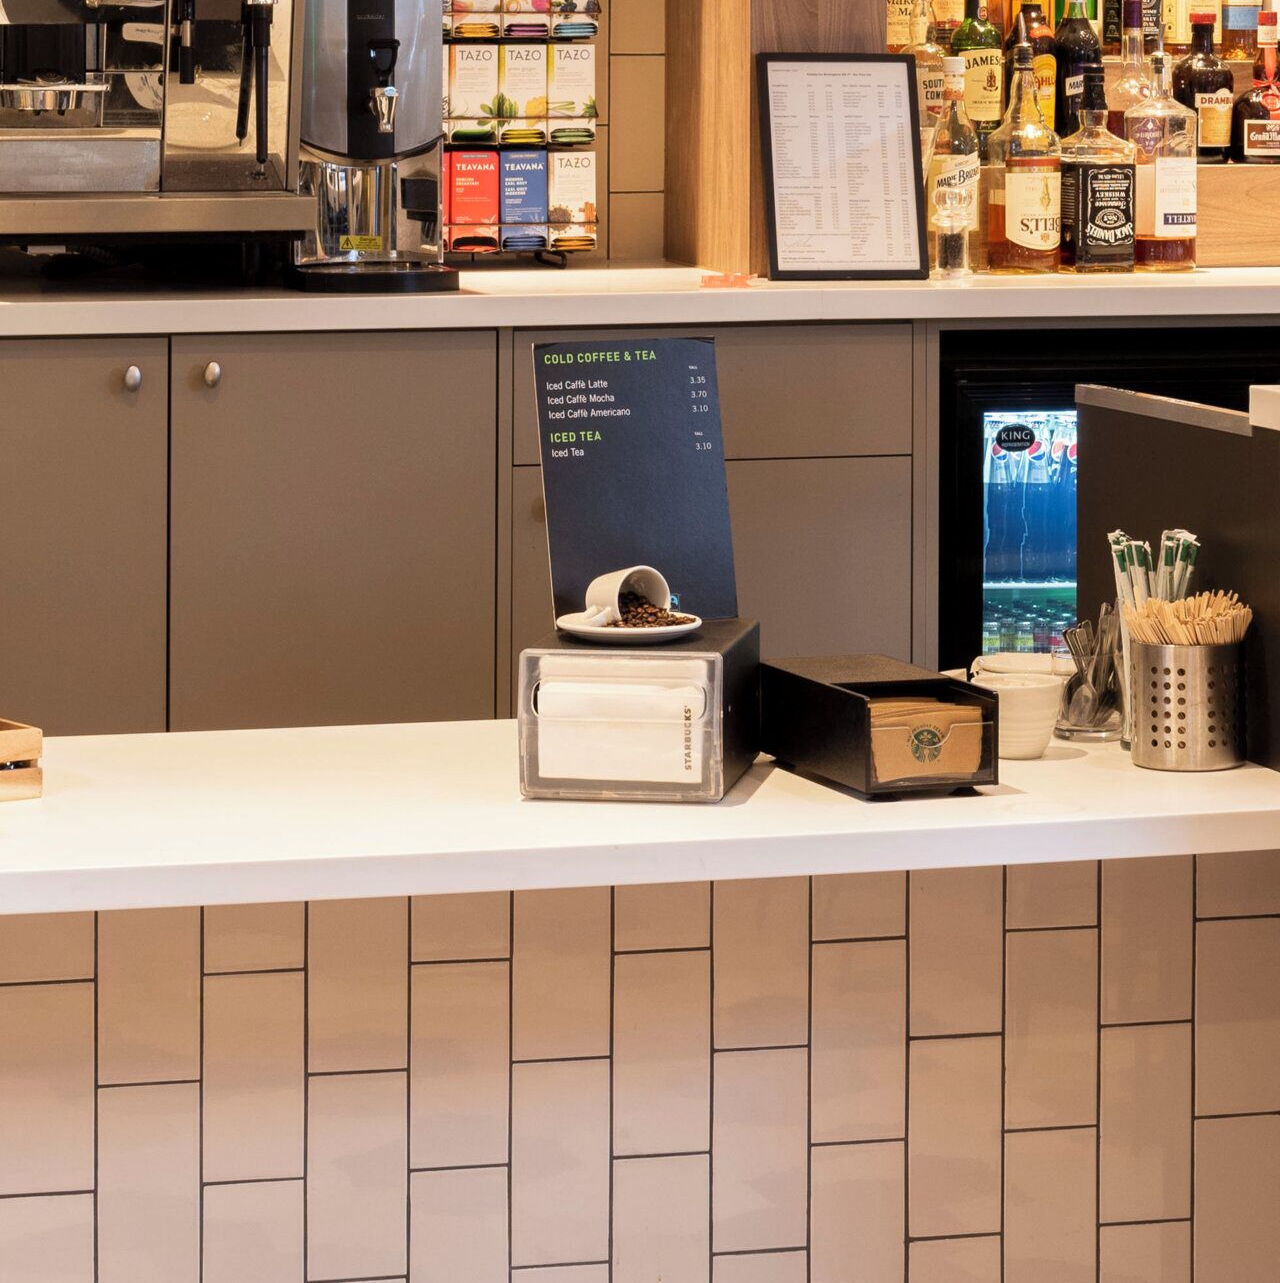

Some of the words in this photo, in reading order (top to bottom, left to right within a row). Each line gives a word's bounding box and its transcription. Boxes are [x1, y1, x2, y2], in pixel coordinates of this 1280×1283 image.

[459, 50, 493, 61] TAZO
[508, 49, 542, 61] TAZO
[557, 49, 591, 60] TAZO
[456, 163, 495, 171] TEAVANA
[505, 163, 544, 171] TEAVANA
[558, 157, 591, 168] TAZO
[1095, 201, 1127, 210] Tennessee
[1084, 222, 1115, 243] DANIEL'S
[1116, 221, 1134, 240] JACK
[544, 353, 574, 365] COLD
[577, 352, 620, 363] COFFEE
[623, 352, 632, 361] &
[634, 350, 657, 361] TEA
[546, 381, 563, 391] Iced
[565, 380, 586, 390] Caffè
[588, 379, 608, 389] Latte
[690, 376, 706, 384] 3.35
[547, 395, 564, 405] Iced
[566, 394, 587, 404] Caffè
[589, 393, 615, 403] Mocha
[691, 390, 708, 399] 3.70
[548, 410, 565, 420] Iced
[567, 408, 588, 419] Caffè
[590, 407, 631, 418] Americano
[692, 404, 709, 413] 3.10
[550, 431, 576, 443] ICED
[579, 430, 602, 442] TEA
[1001, 430, 1031, 441] KING
[695, 442, 712, 451] 3.10
[551, 448, 568, 458] Iced
[570, 447, 584, 457] Tea
[684, 706, 693, 771] STARBUCKS
